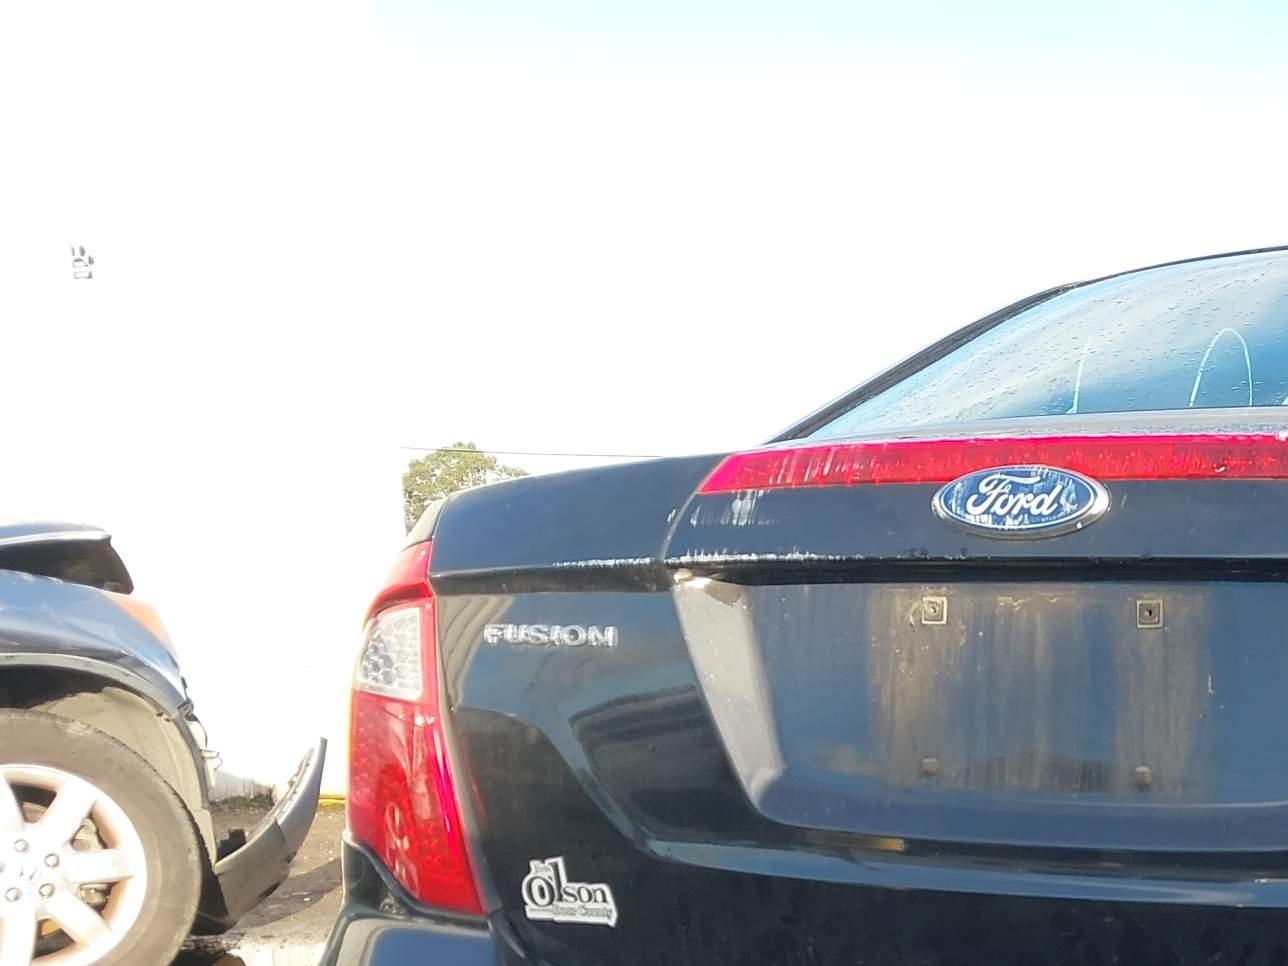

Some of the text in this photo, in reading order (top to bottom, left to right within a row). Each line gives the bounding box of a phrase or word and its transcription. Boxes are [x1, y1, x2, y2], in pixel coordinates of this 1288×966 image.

[966, 474, 1062, 516] Ford
[484, 624, 618, 648] FUSION
[525, 862, 609, 908] Olson
